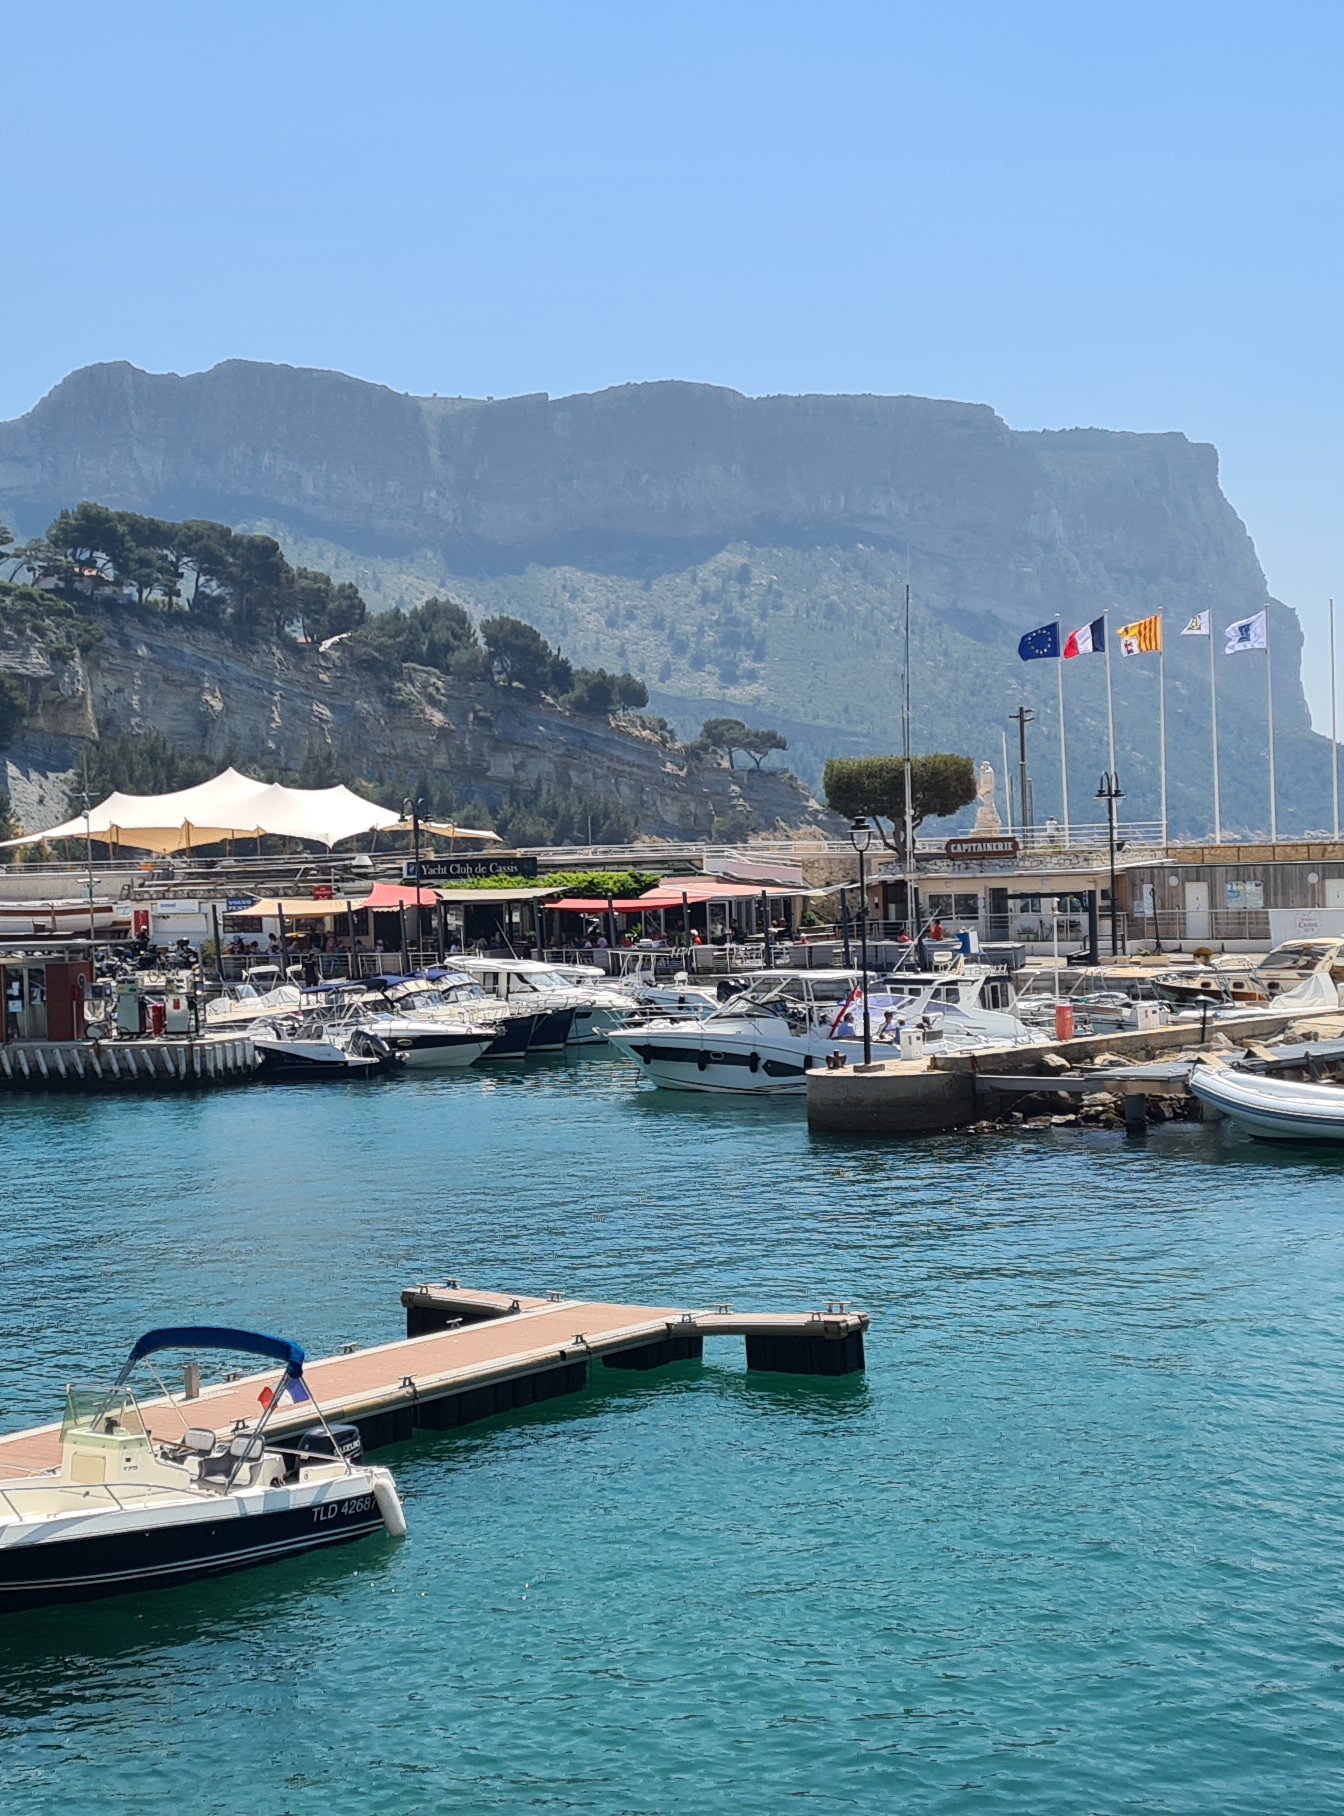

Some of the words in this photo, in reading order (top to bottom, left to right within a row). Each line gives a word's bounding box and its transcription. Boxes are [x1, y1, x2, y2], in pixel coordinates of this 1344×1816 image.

[950, 842, 1014, 853] CAPITAINERIE
[421, 865, 447, 875] Yacht
[449, 863, 473, 875] Club
[474, 863, 487, 873] de
[489, 862, 518, 873] Cassis
[312, 1504, 338, 1522] TLD
